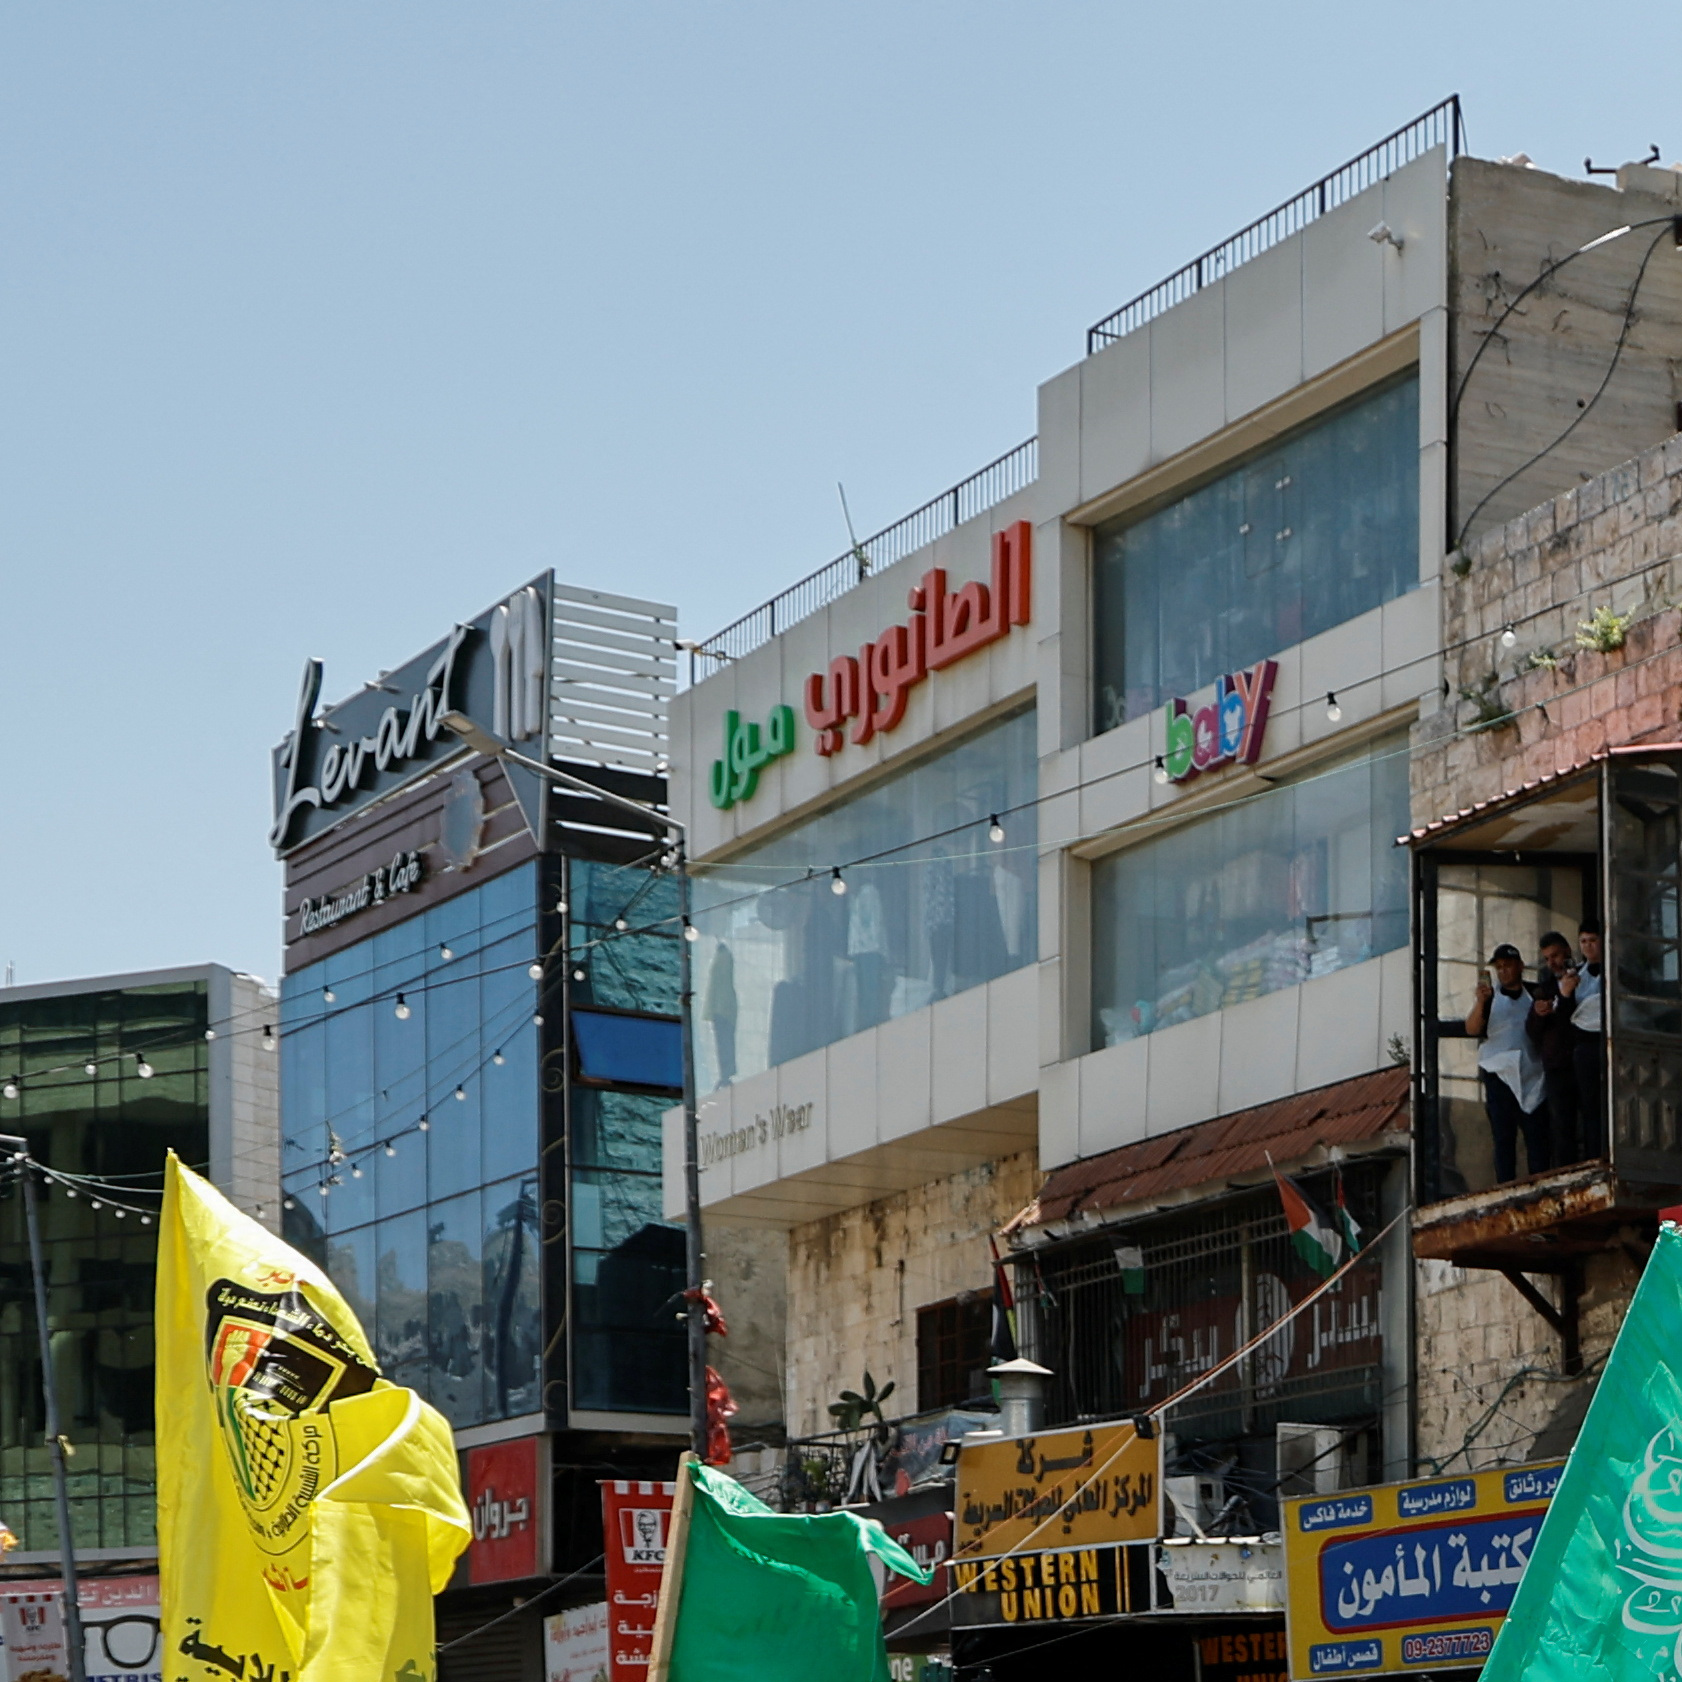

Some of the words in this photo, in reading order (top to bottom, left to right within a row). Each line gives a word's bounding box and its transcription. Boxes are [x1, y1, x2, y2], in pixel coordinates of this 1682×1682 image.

[804, 519, 1031, 757] الطانوري
[269, 622, 475, 848] Levant
[1164, 659, 1279, 784] baby
[708, 704, 794, 810] مول
[300, 873, 371, 935] Restaurant
[769, 1101, 814, 1141] Wear
[1016, 1430, 1094, 1483] شركة
[1109, 1472, 1153, 1519] المركز
[1338, 1500, 1368, 1520] خدمة
[1401, 1491, 1443, 1514] مدرسية
[1442, 1484, 1472, 1508] لوازم
[1303, 1503, 1336, 1529] فاكس
[631, 1549, 667, 1562] KFC
[954, 1548, 1099, 1594] WESTERN
[1452, 1526, 1534, 1604] كتبة
[1175, 1584, 1220, 1603] 2017
[1337, 1541, 1443, 1619] المأمون
[1000, 1582, 1101, 1622] UNION
[1312, 1644, 1347, 1672] أطفال
[1347, 1640, 1379, 1667] قصص
[1403, 1632, 1492, 1659] 09-2377723
